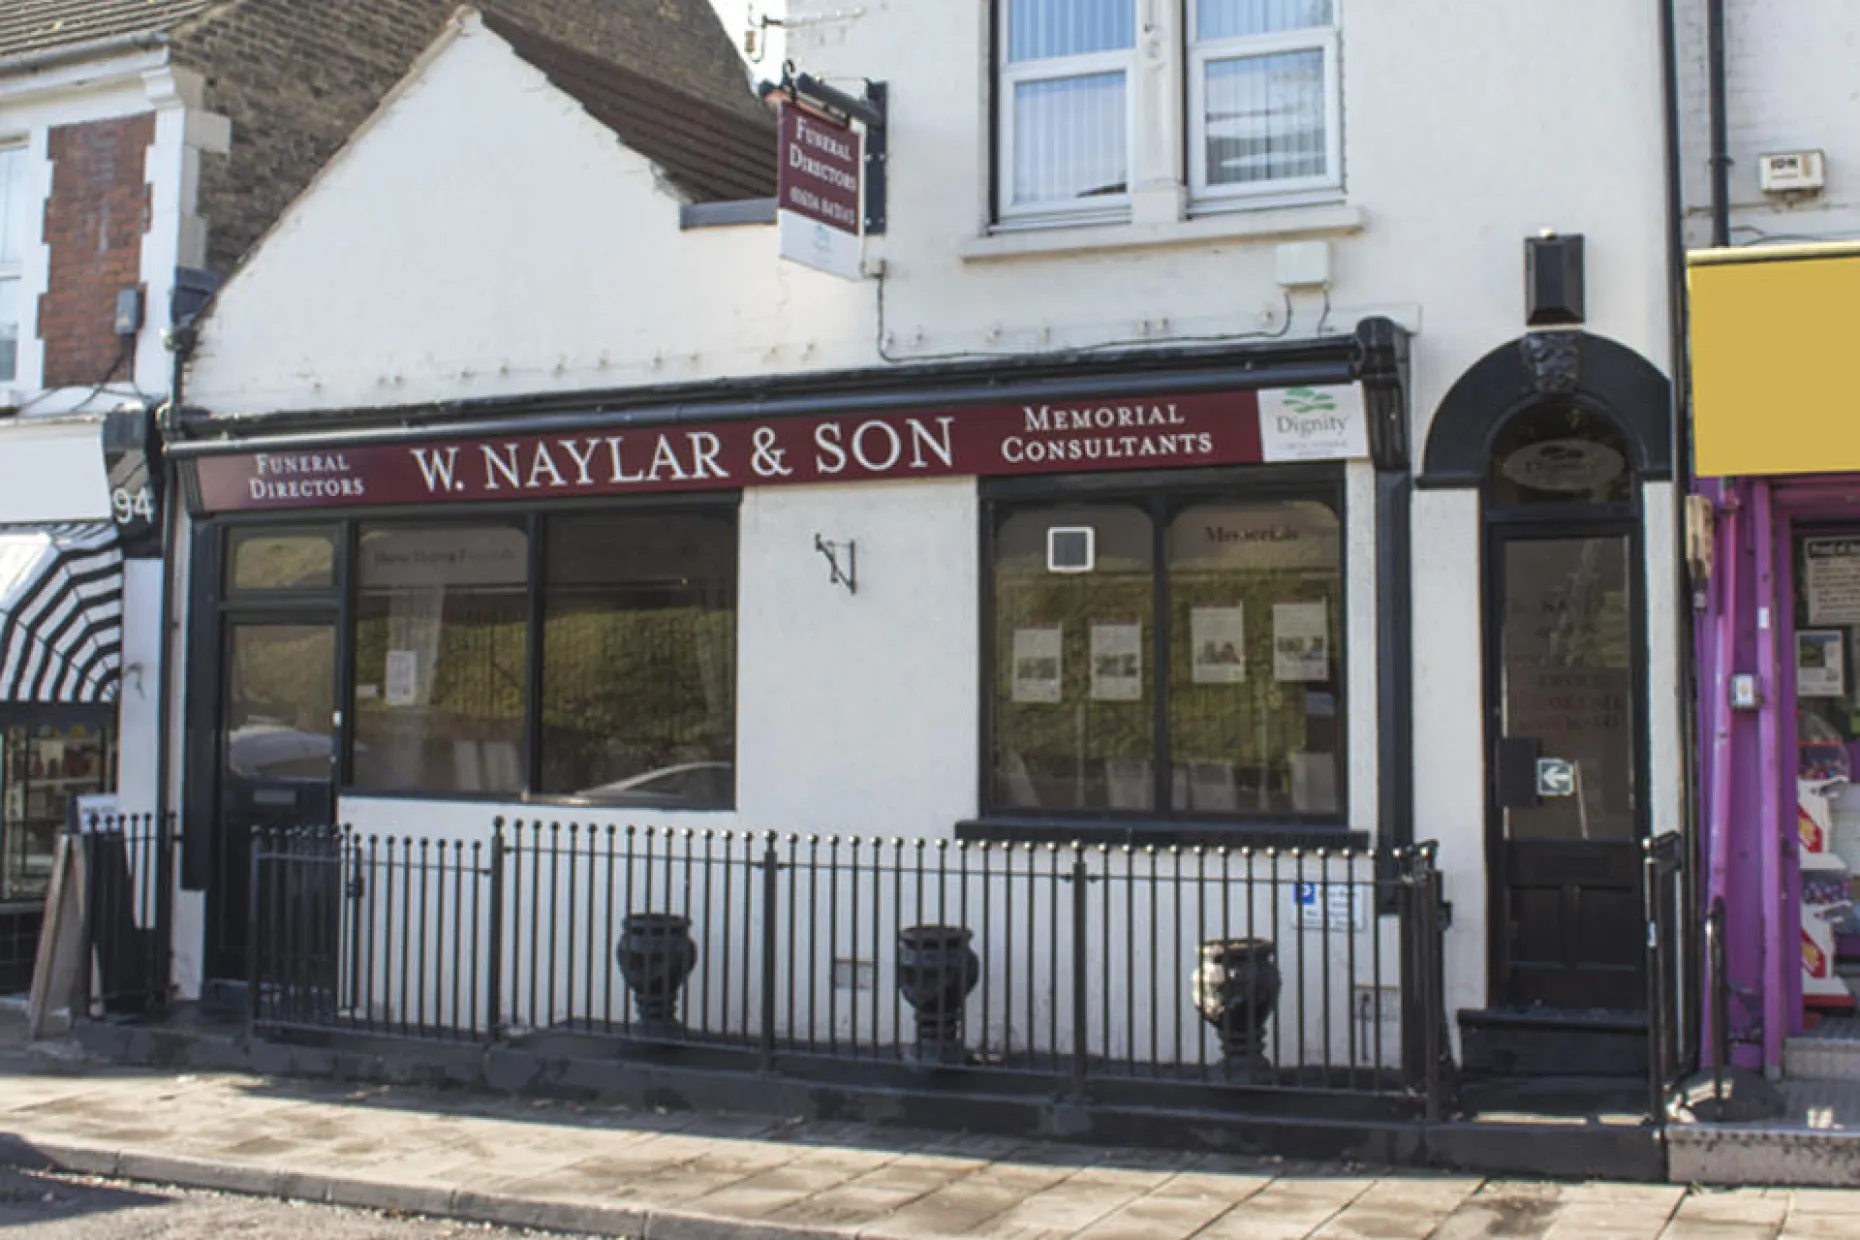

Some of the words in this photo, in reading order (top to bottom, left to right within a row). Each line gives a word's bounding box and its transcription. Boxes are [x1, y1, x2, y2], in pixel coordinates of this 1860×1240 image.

[796, 116, 852, 161] FUNERAL
[789, 142, 857, 191] DIRECTORS
[1022, 404, 1186, 432] MEMORIAL
[1276, 413, 1348, 438] Dignity
[409, 446, 465, 493] W.
[480, 431, 730, 490] NAYLAR
[751, 426, 794, 476] &
[814, 416, 955, 474] SON
[1001, 432, 1213, 463] CONSULTANTS
[254, 452, 350, 475] FUNERAL
[249, 476, 365, 500] DIRECTORS
[113, 487, 154, 524] 94
